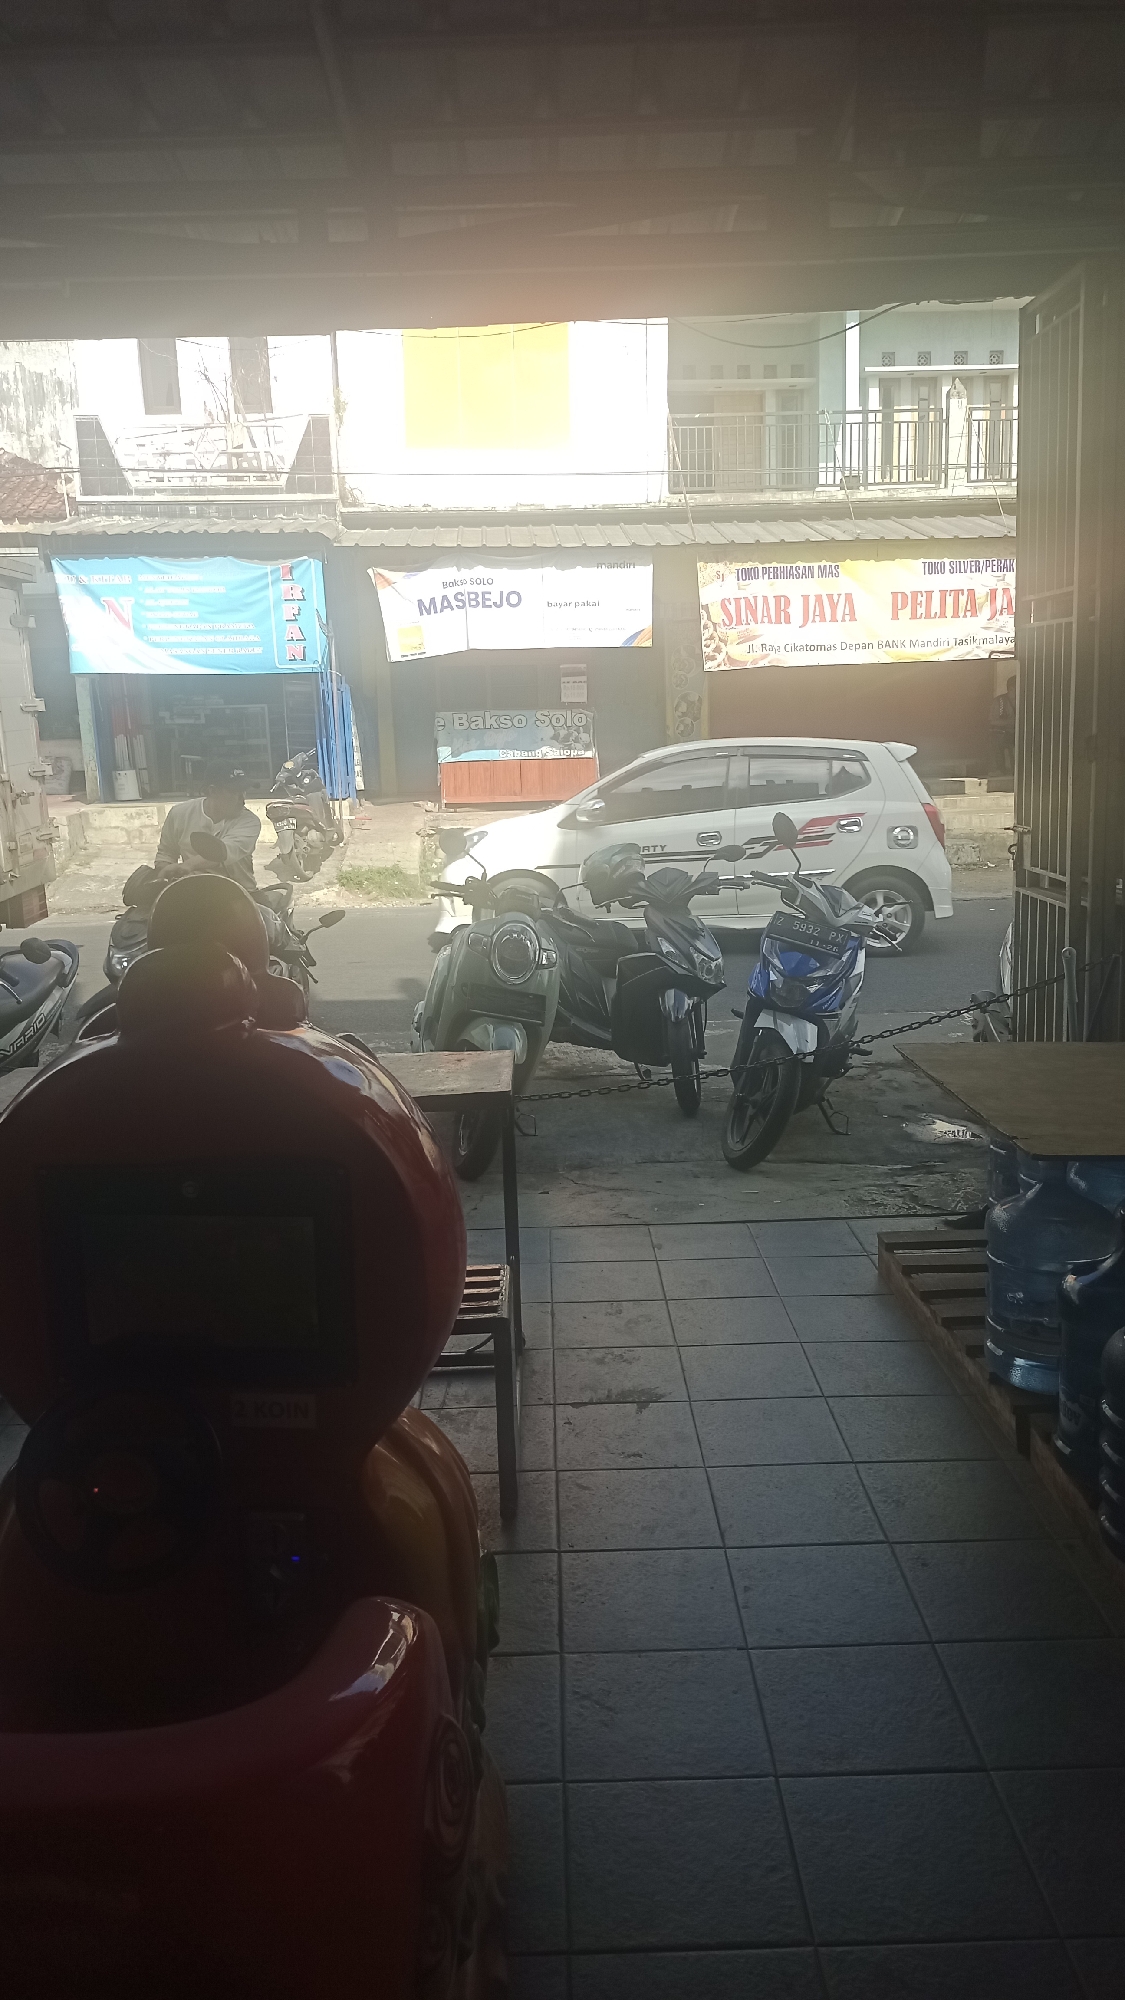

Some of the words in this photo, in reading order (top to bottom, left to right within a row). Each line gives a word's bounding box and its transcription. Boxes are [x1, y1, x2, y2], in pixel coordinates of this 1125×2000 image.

[735, 566, 760, 582] TOKO
[762, 565, 814, 580] PERHIASAN
[817, 564, 840, 578] MAS
[922, 561, 946, 575] TOKO
[949, 559, 1015, 575] SILVER/PERAK
[469, 577, 494, 587] SOLO
[417, 590, 523, 617] MASBEJO
[547, 600, 572, 609] bayar
[574, 600, 600, 609] pakai
[720, 594, 792, 628] SINAR
[799, 592, 858, 628] JAYA
[891, 588, 979, 621] PELITA
[784, 641, 838, 653] Cikatomas
[840, 640, 874, 652] Depan
[877, 639, 907, 650] BANK
[909, 638, 950, 648] Mandiri
[452, 711, 528, 731] Bakso
[535, 709, 588, 728] Solo
[777, 916, 785, 926] Z
[792, 921, 821, 937] 5932
[828, 931, 844, 945] PX
[0, 1012, 46, 1056] VARIO
[254, 1400, 309, 1418] KOIN
